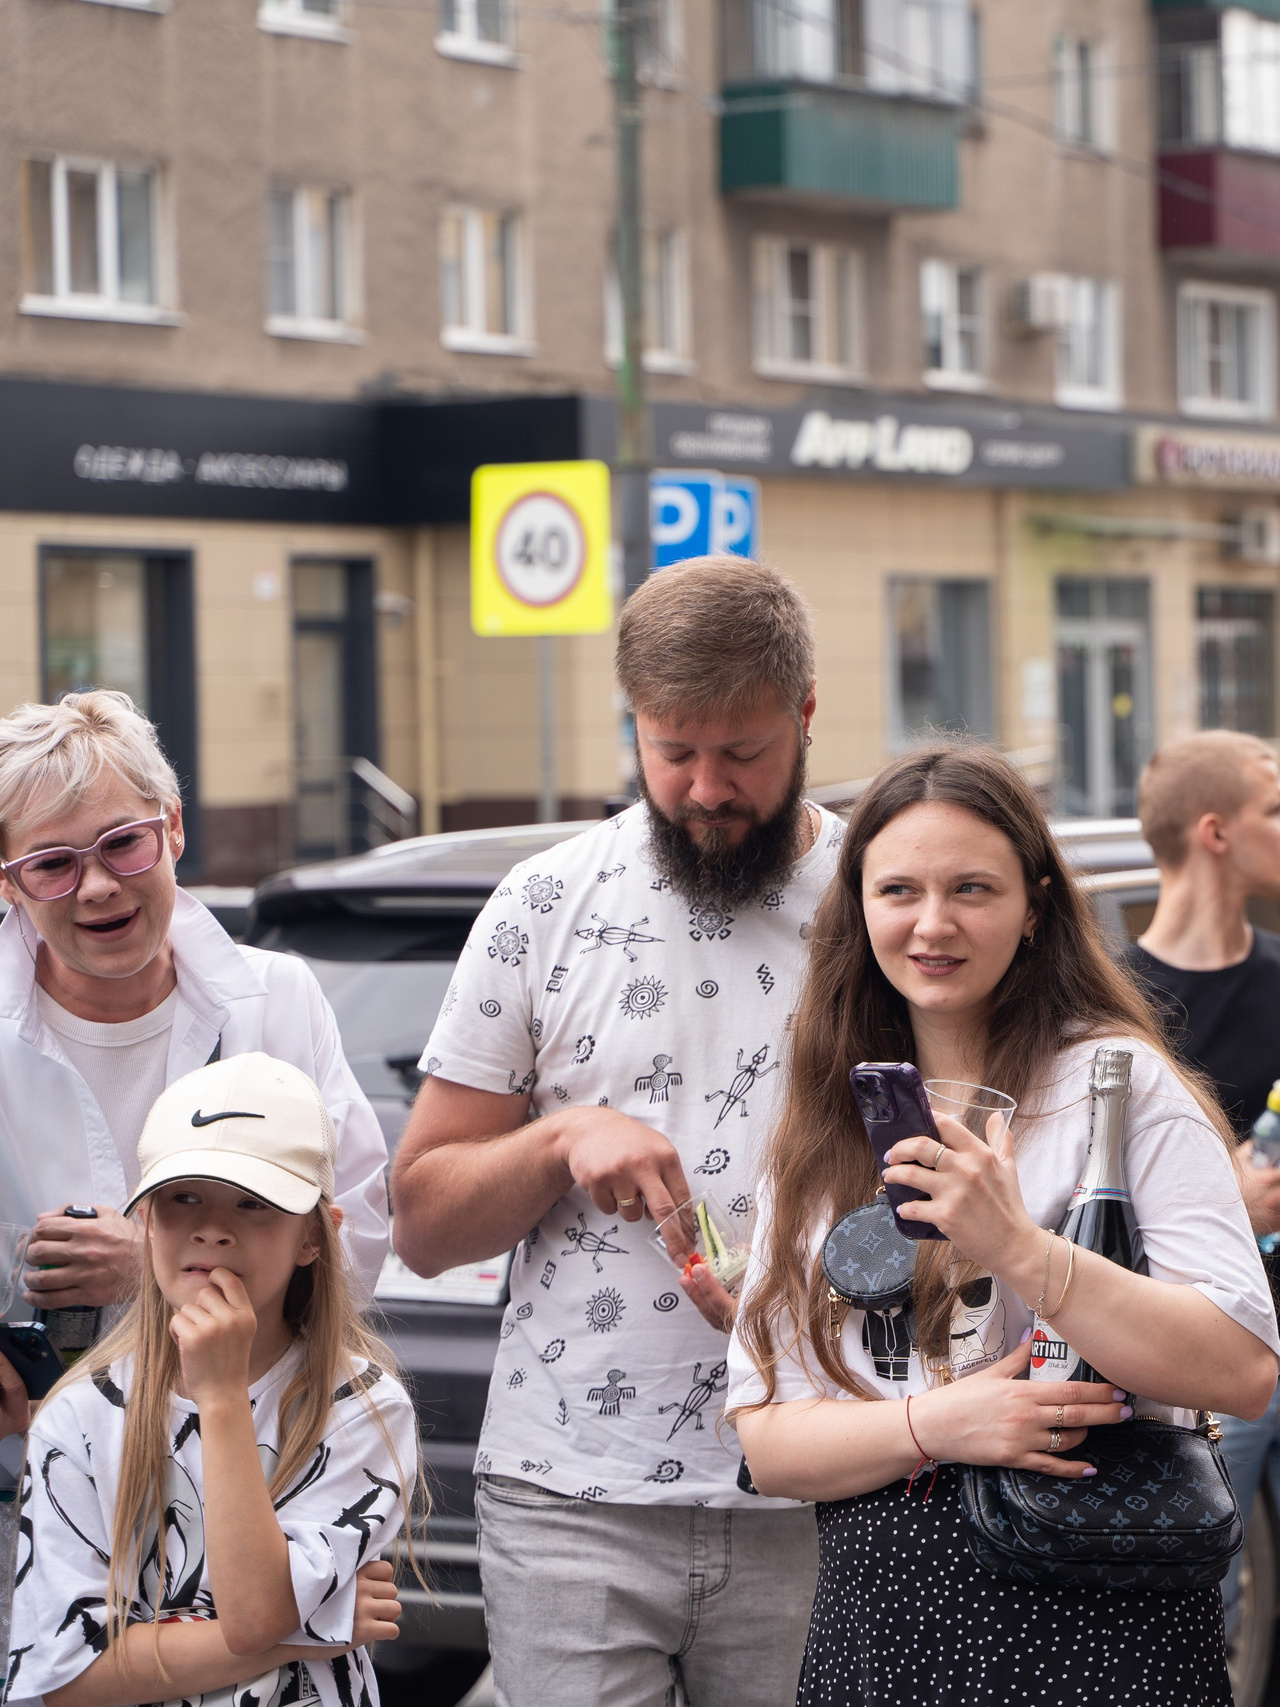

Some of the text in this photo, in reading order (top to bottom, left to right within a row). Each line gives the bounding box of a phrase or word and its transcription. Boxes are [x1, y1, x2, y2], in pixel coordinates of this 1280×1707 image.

[511, 524, 571, 574] 40
[1032, 1341, 1066, 1358] RTINI
[958, 1354, 998, 1373] LAGERFELD
